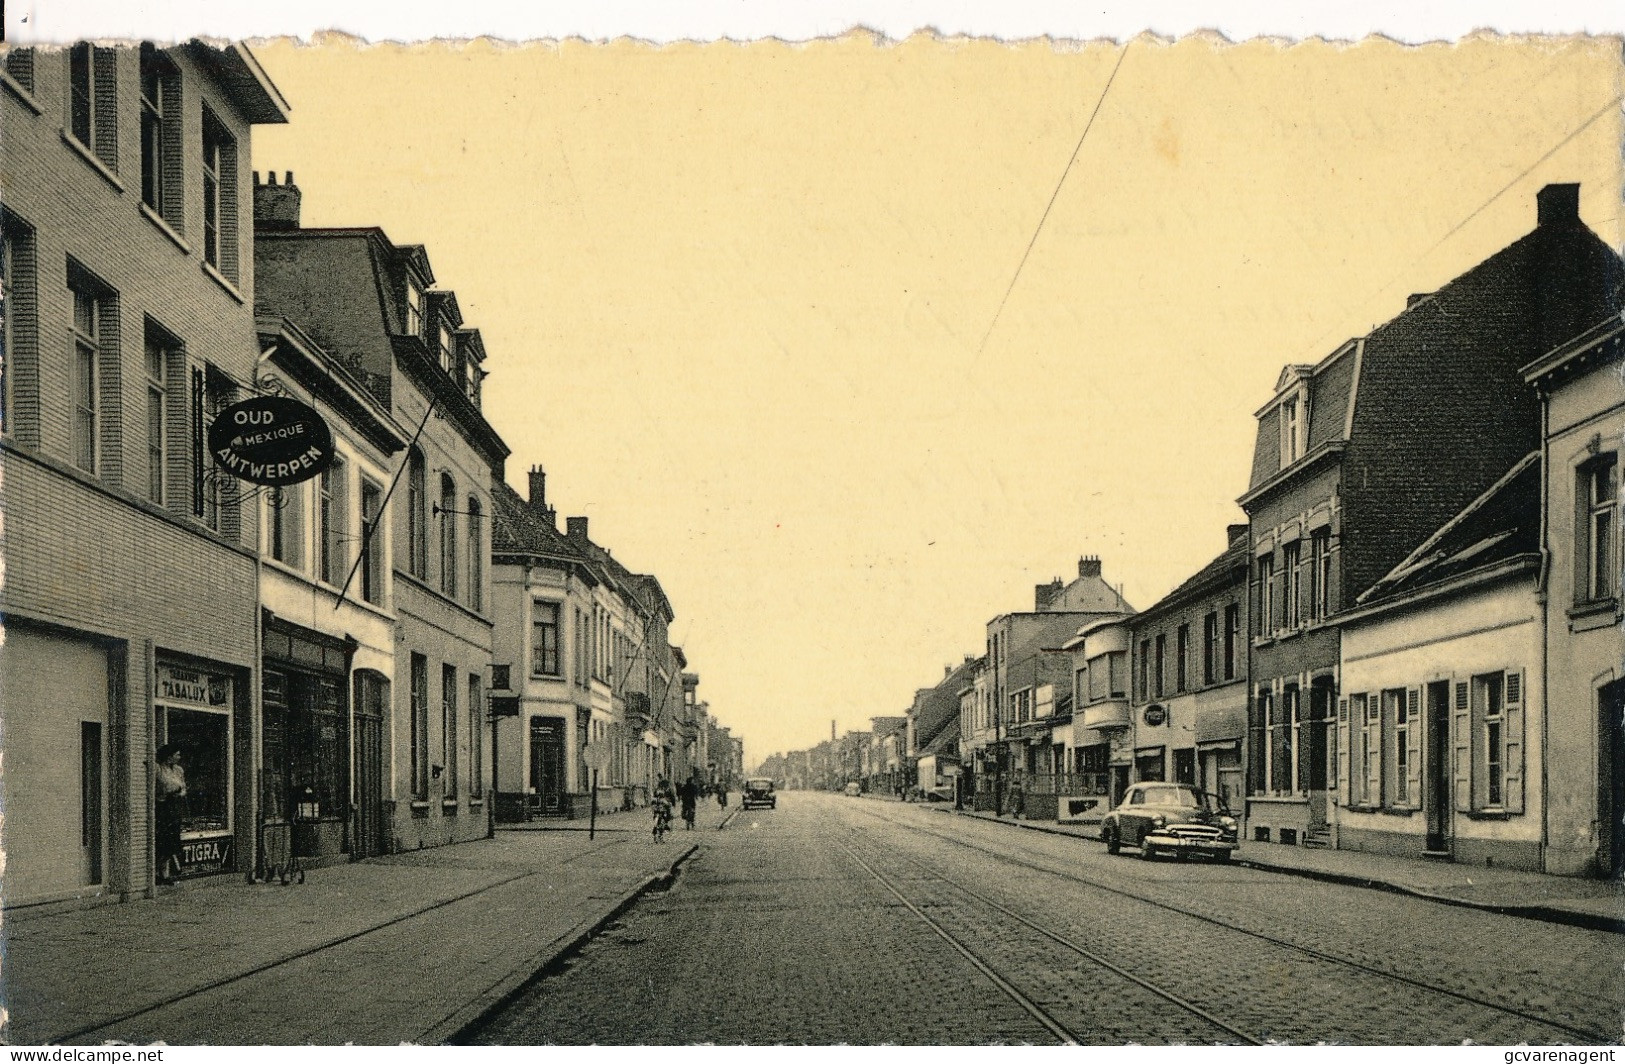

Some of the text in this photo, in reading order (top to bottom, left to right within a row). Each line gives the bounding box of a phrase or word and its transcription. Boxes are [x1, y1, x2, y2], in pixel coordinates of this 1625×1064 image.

[234, 410, 274, 425] OUD
[245, 423, 304, 446] MEXIQUE
[217, 445, 323, 479] ANTWERPEN
[162, 680, 206, 702] TABALUX
[182, 842, 220, 863] TIGRA
